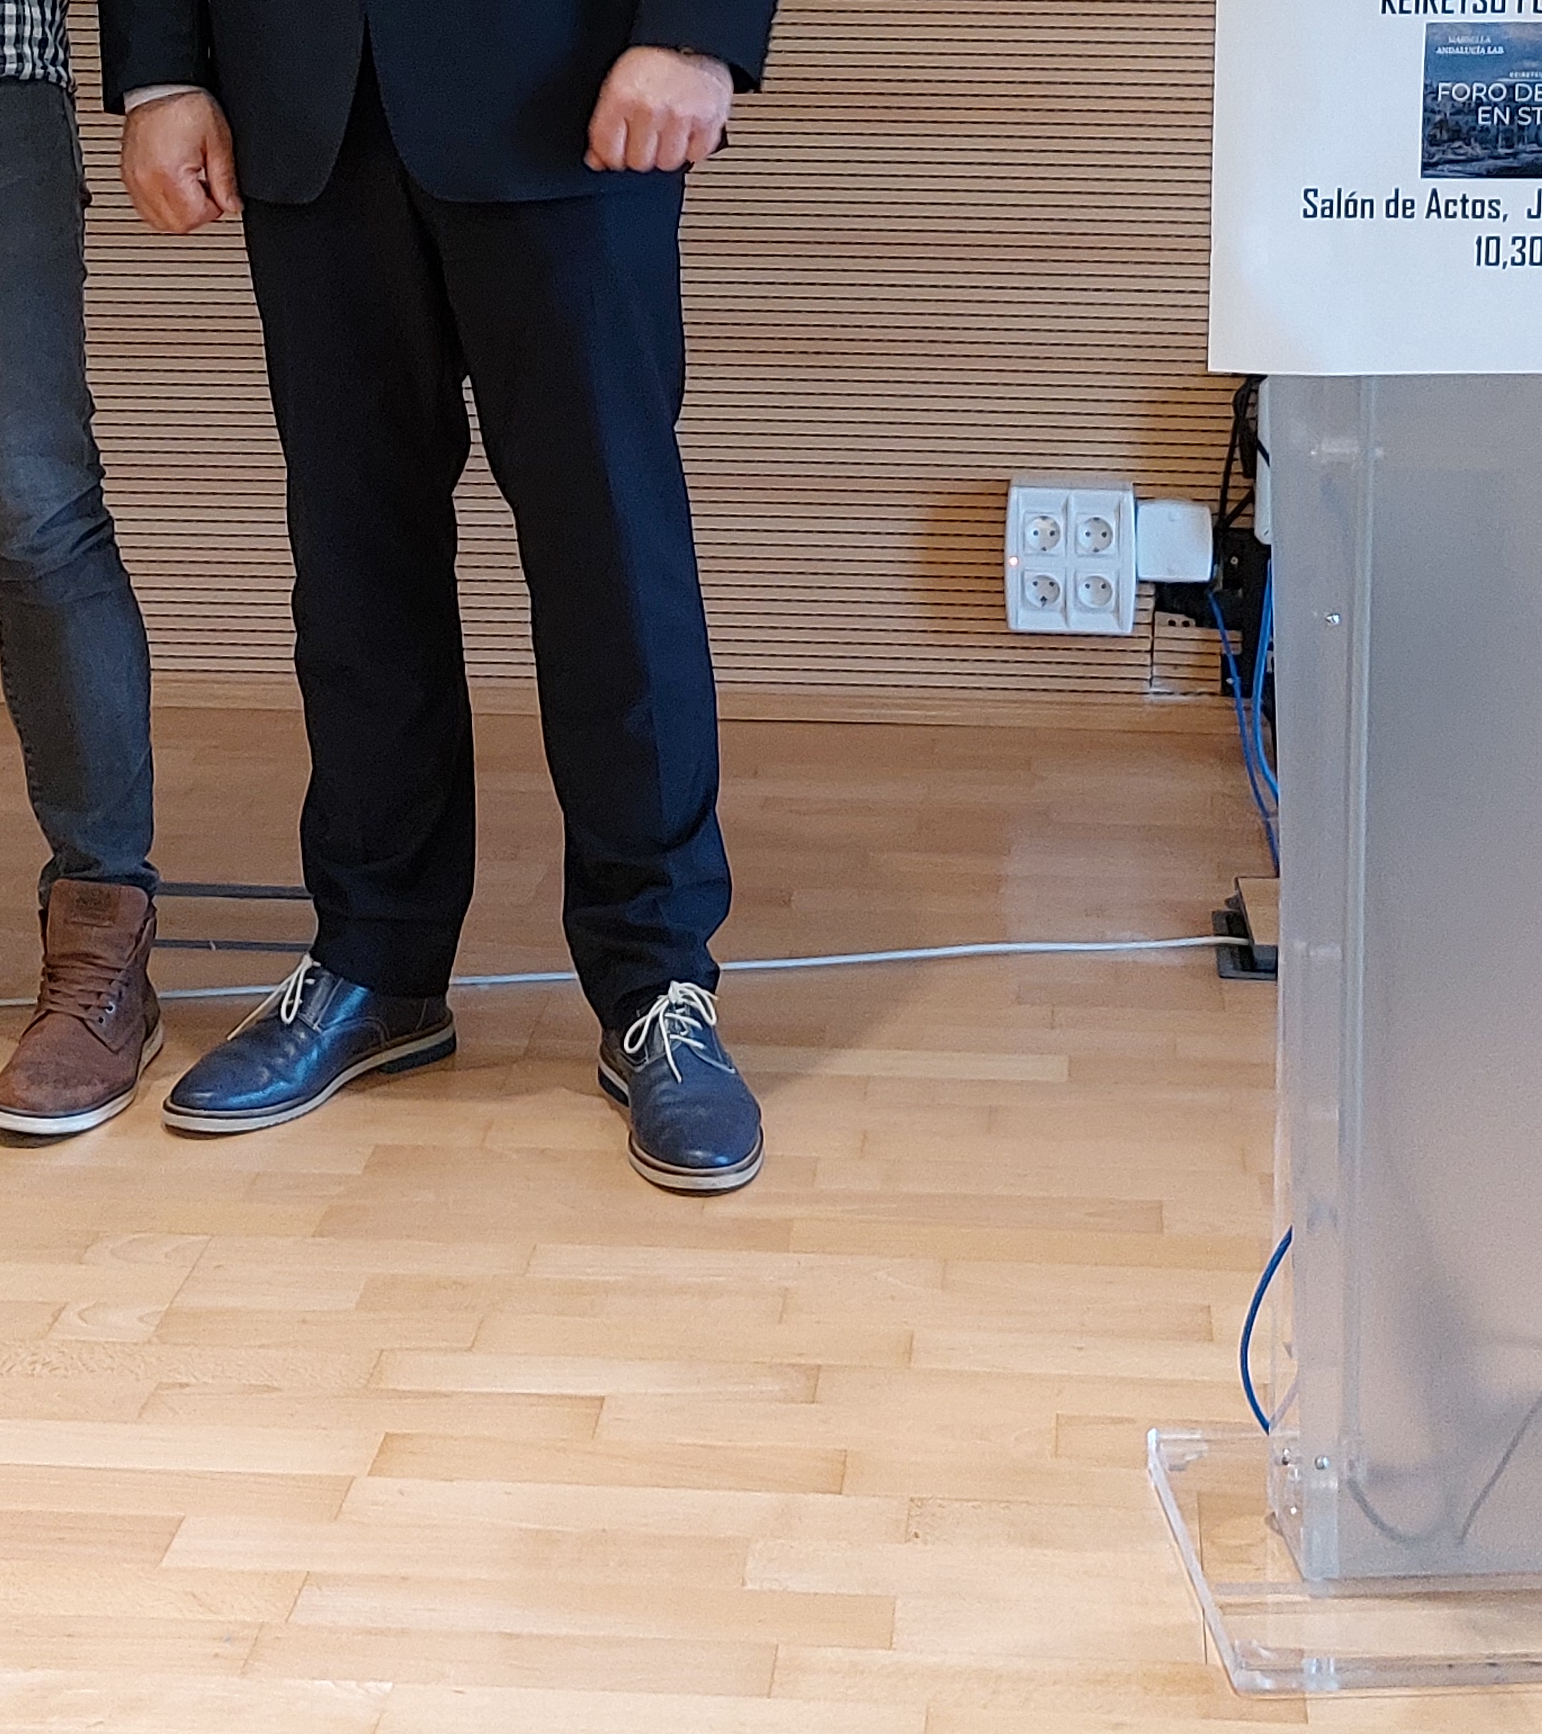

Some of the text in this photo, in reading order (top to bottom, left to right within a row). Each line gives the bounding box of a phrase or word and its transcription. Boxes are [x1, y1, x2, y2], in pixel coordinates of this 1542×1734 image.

[1437, 82, 1507, 103] FORO
[1478, 106, 1509, 125] EN
[1302, 187, 1375, 219] Salón
[1385, 187, 1416, 219] de
[1424, 188, 1509, 223] Actos,
